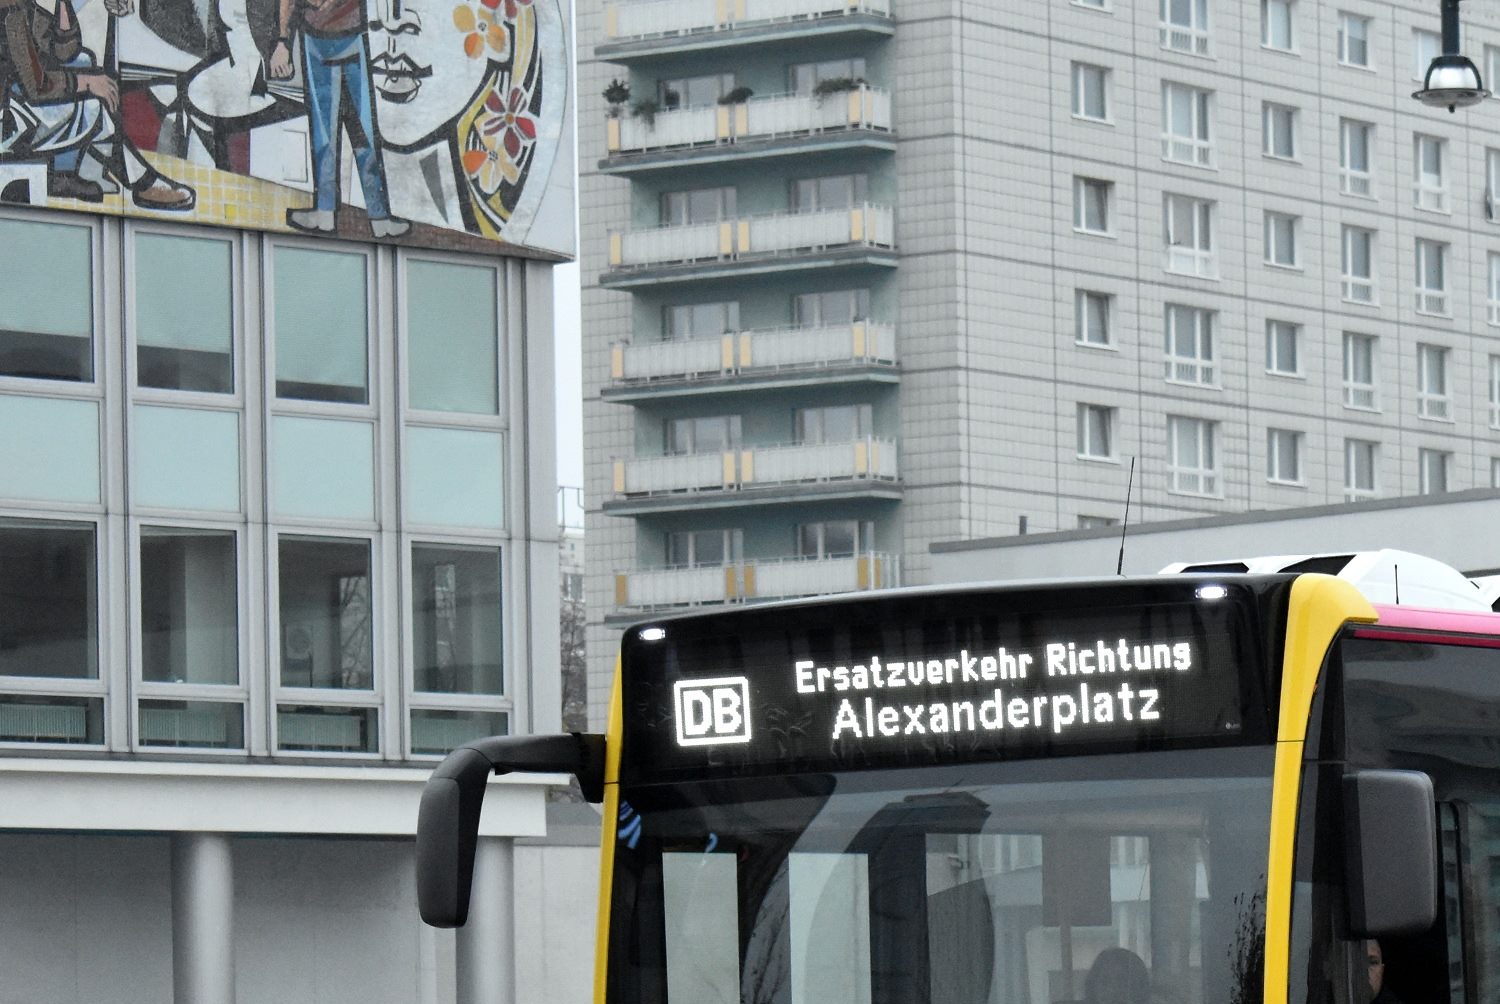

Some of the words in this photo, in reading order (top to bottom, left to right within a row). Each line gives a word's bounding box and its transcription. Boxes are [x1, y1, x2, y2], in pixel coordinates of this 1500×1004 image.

[795, 647, 1033, 695] Ersatzverkehr
[1047, 638, 1193, 677] Richtung
[678, 681, 749, 741] DB
[831, 682, 1161, 741] Alexanderplatz
